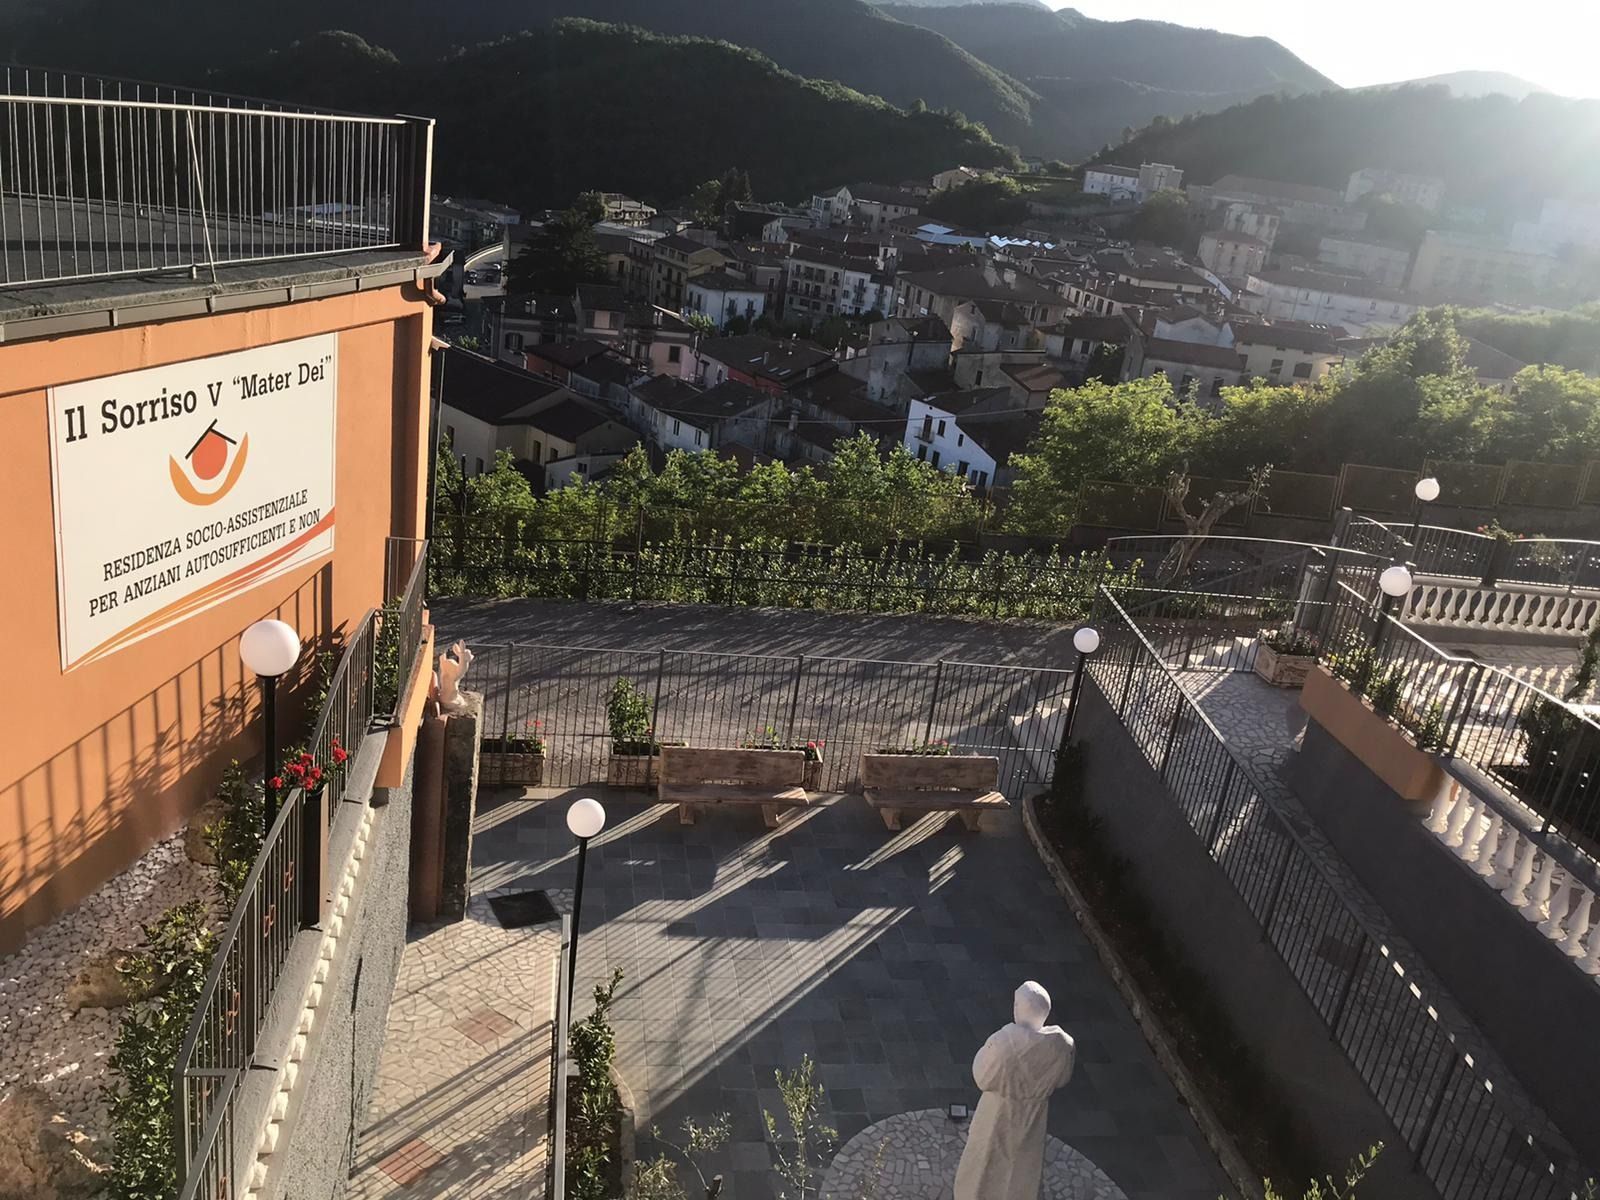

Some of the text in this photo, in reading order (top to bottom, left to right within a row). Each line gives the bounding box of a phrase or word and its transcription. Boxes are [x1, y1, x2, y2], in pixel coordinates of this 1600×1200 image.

[65, 406, 87, 443] Il
[101, 388, 197, 434] Sorriso
[207, 382, 223, 407] V
[89, 508, 320, 618] PER ANZIANI AUTOSUFFICIENTI E NON
[103, 489, 308, 581] RESIDENZA SOCIO-ASSISTENZIALE
